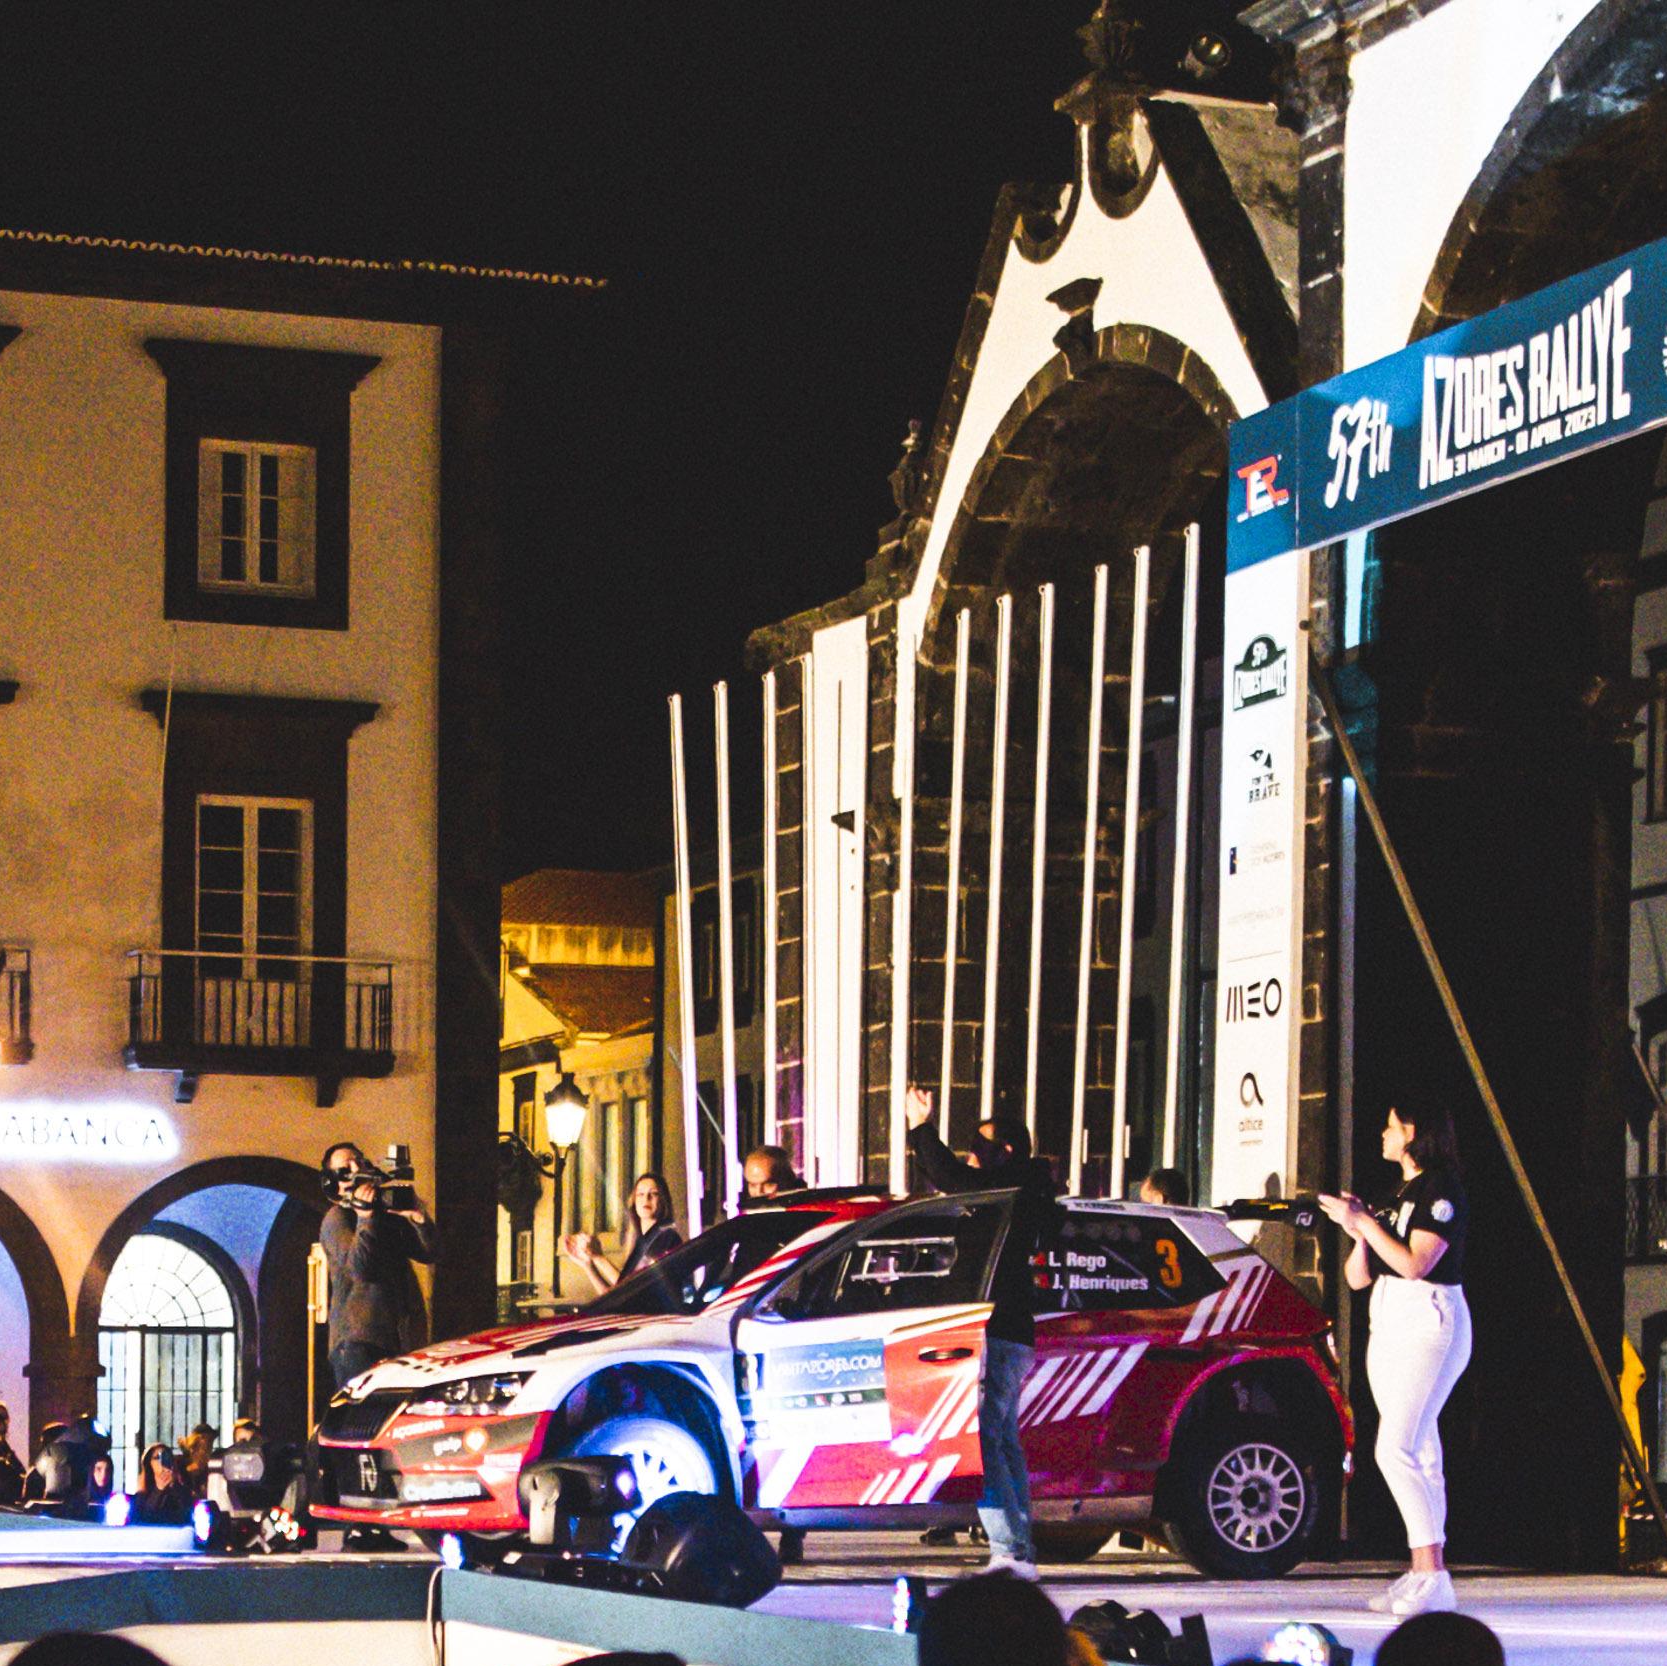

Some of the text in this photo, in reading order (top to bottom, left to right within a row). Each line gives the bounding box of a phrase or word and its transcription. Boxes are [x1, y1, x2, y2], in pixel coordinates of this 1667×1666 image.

[1419, 268, 1632, 490] AZORES RALLYE
[1325, 397, 1393, 509] 57th
[1226, 977, 1282, 1023] MEO
[2, 1114, 167, 1148] ABANCA
[1048, 1251, 1107, 1273] L. Rego
[1052, 1274, 1149, 1293] J. Henriques
[1155, 1239, 1183, 1288] 3
